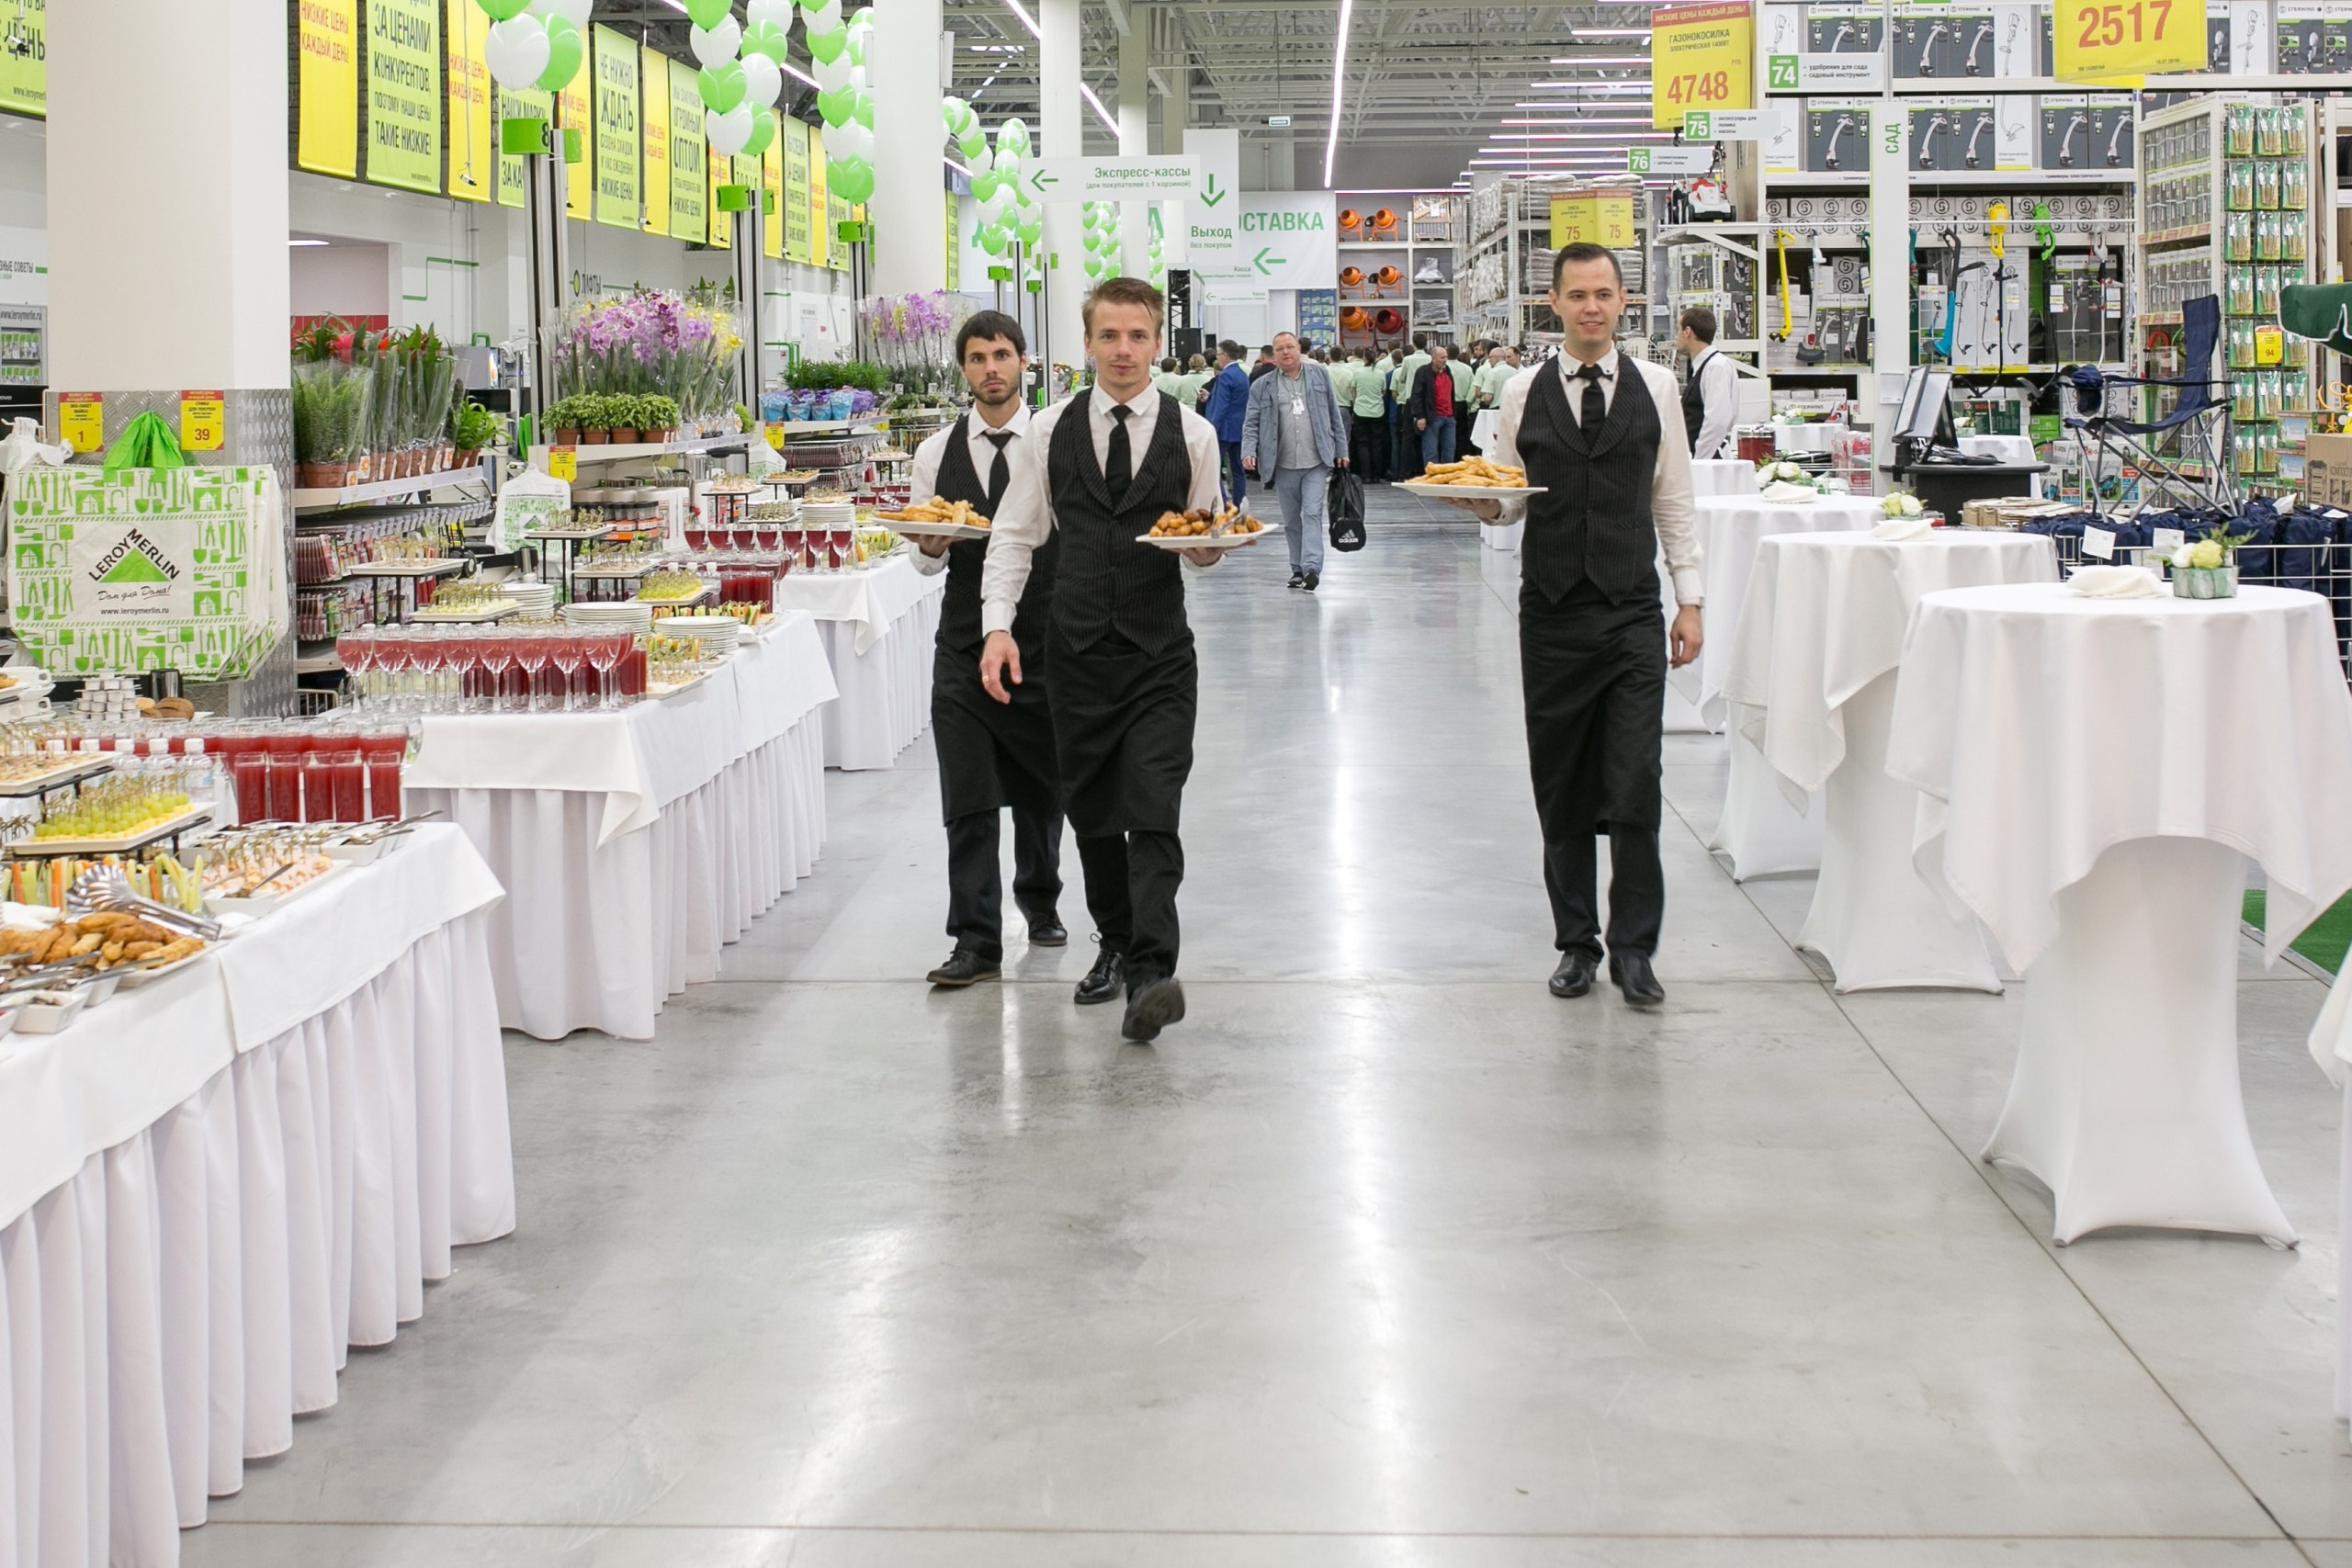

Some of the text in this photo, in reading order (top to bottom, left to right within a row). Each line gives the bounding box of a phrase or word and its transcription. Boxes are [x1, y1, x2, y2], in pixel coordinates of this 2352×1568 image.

[301, 2, 349, 35] НИЗКИЕ ЦЕНЫ
[1656, 12, 1679, 22] НИЗКИЕ
[1679, 10, 1697, 21] ЦЕНЫ
[1697, 6, 1725, 17] КАЖДЫЙ
[374, 3, 431, 54] ЗА ЦЕНАМИ
[2078, 0, 2172, 48] 2517
[301, 32, 331, 58] КАЖДЫЙ
[1669, 28, 1730, 43] ГАЗОНОКОСИЛКА
[600, 52, 632, 90] НЕ НУЖНО
[1771, 66, 1796, 85] 74
[1668, 71, 1728, 104] 4748
[374, 91, 400, 112] ПОЭТОМУ
[401, 98, 415, 118] НАШИ
[601, 86, 633, 133] ЖДАТЬ
[375, 120, 399, 148] ТАКИЕ
[541, 121, 549, 147] 8
[1689, 120, 1708, 136] 75
[1884, 122, 1901, 153] САД
[1631, 155, 1648, 169] 76
[503, 161, 512, 187] ЗА
[1095, 167, 1191, 179] Экспресс-кассы
[1102, 180, 1144, 188] покупателей
[1158, 180, 1191, 188] корзиной)
[1238, 212, 1324, 231] СТАВКА
[1191, 225, 1232, 239] Выход
[1566, 226, 1580, 241] 75
[1610, 224, 1621, 239] 75
[14, 261, 33, 274] СОВЕТЫ
[582, 273, 601, 295] ЛИФТЫ
[78, 431, 84, 443] 1
[195, 428, 209, 441] 39
[88, 537, 130, 581] LEROY
[127, 528, 180, 580] MERLIN
[97, 584, 172, 602] Дом для Дома!
[100, 607, 169, 615] www.leroymerlin.ru
